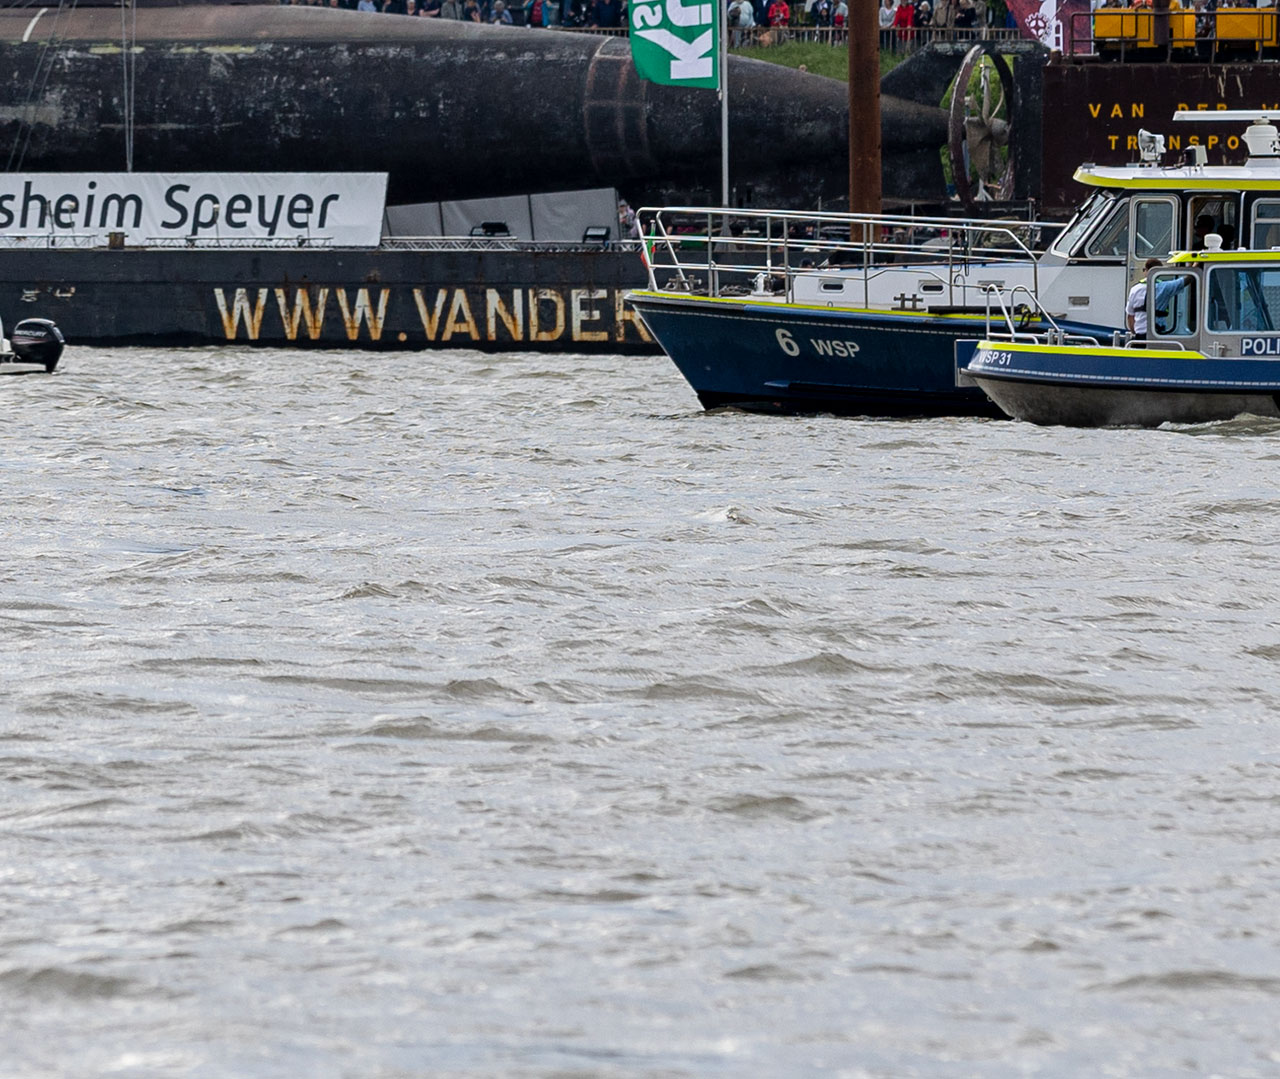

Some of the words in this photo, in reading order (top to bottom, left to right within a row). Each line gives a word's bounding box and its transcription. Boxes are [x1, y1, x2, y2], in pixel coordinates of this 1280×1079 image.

[1088, 103, 1145, 119] VAN
[160, 183, 340, 236] Speyer
[775, 328, 800, 357] 6
[810, 338, 860, 358] WSP
[999, 352, 1012, 366] 31
